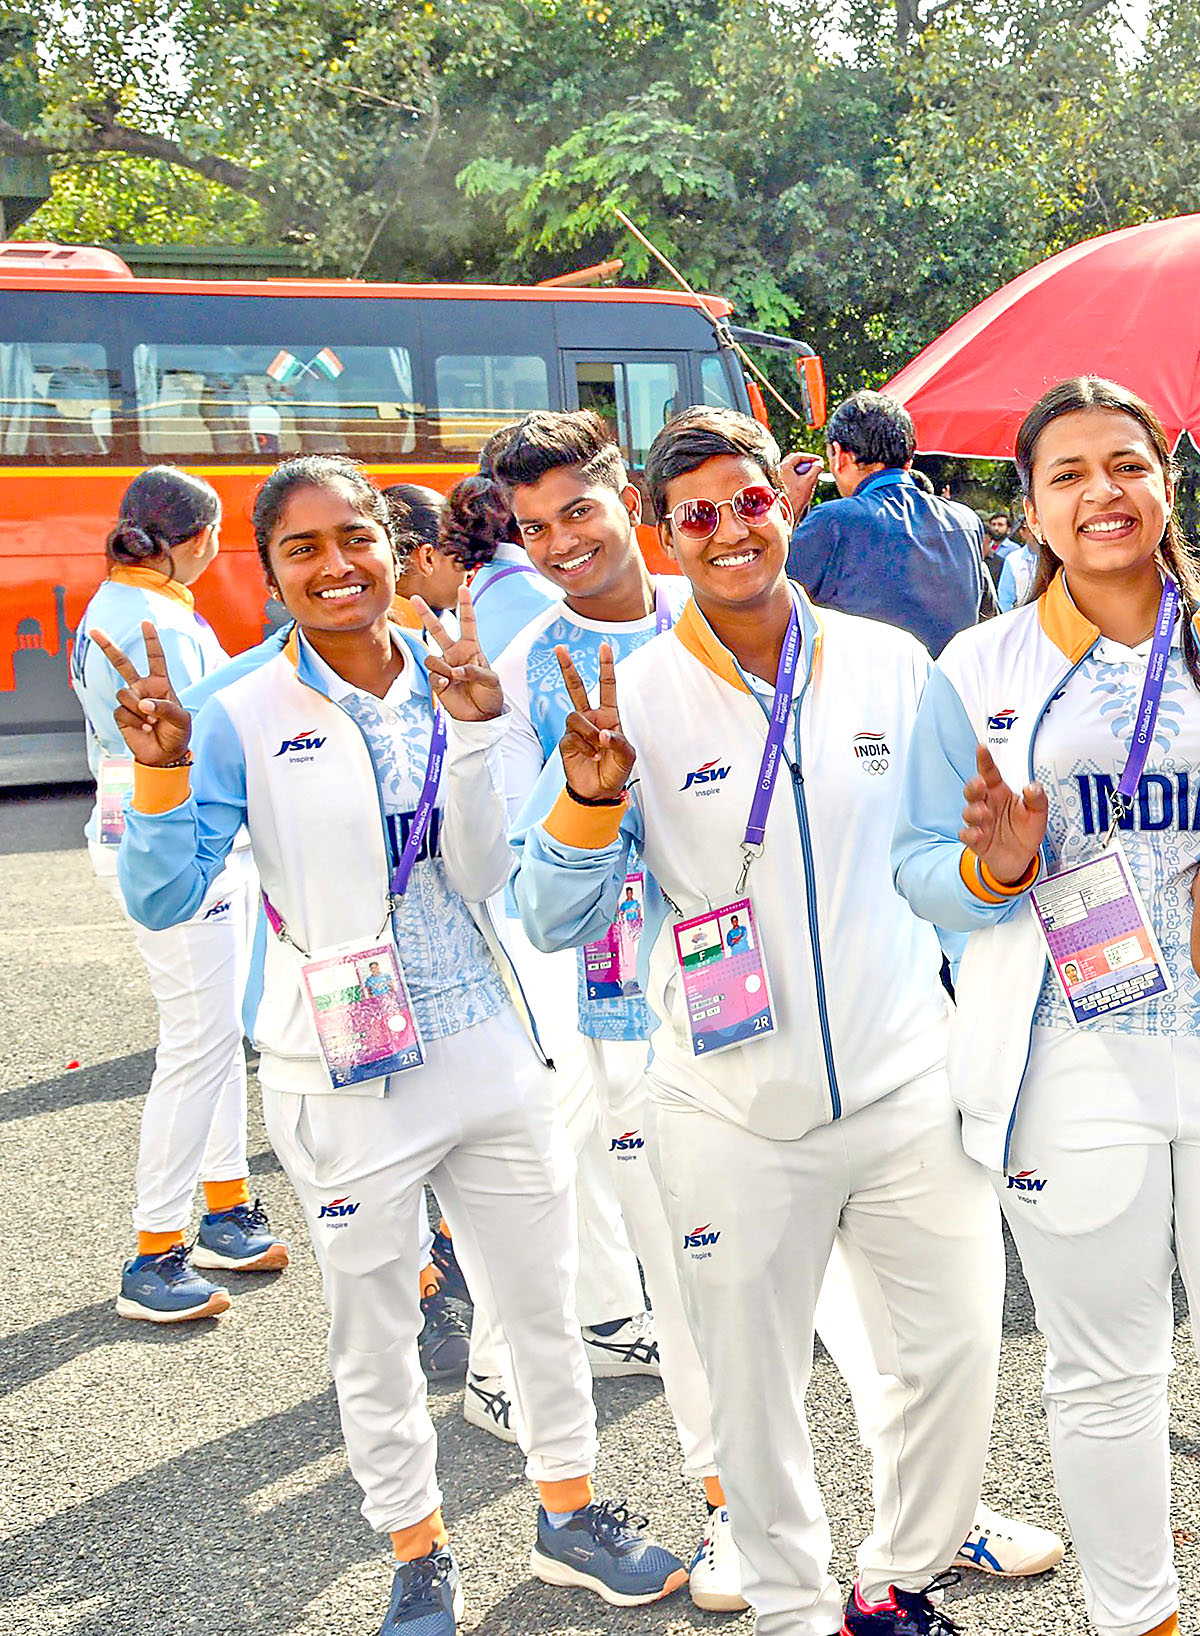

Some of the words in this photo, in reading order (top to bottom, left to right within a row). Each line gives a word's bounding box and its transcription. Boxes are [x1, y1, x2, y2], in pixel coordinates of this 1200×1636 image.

[273, 737, 327, 757] JSW
[854, 743, 891, 758] INDIA
[288, 755, 315, 764] Inspire
[678, 766, 732, 792] JSW
[694, 787, 721, 798] Inspire
[698, 951, 706, 961] F
[589, 986, 597, 997] S
[753, 1015, 770, 1031] 2R
[697, 1039, 705, 1050] S
[401, 1051, 419, 1066] 2R
[335, 1073, 345, 1084] S
[608, 1138, 645, 1151] JSW
[1006, 1176, 1048, 1191] JSW
[317, 1202, 361, 1218] JSW
[683, 1231, 721, 1250] JSW
[691, 1251, 712, 1261] Inspire
